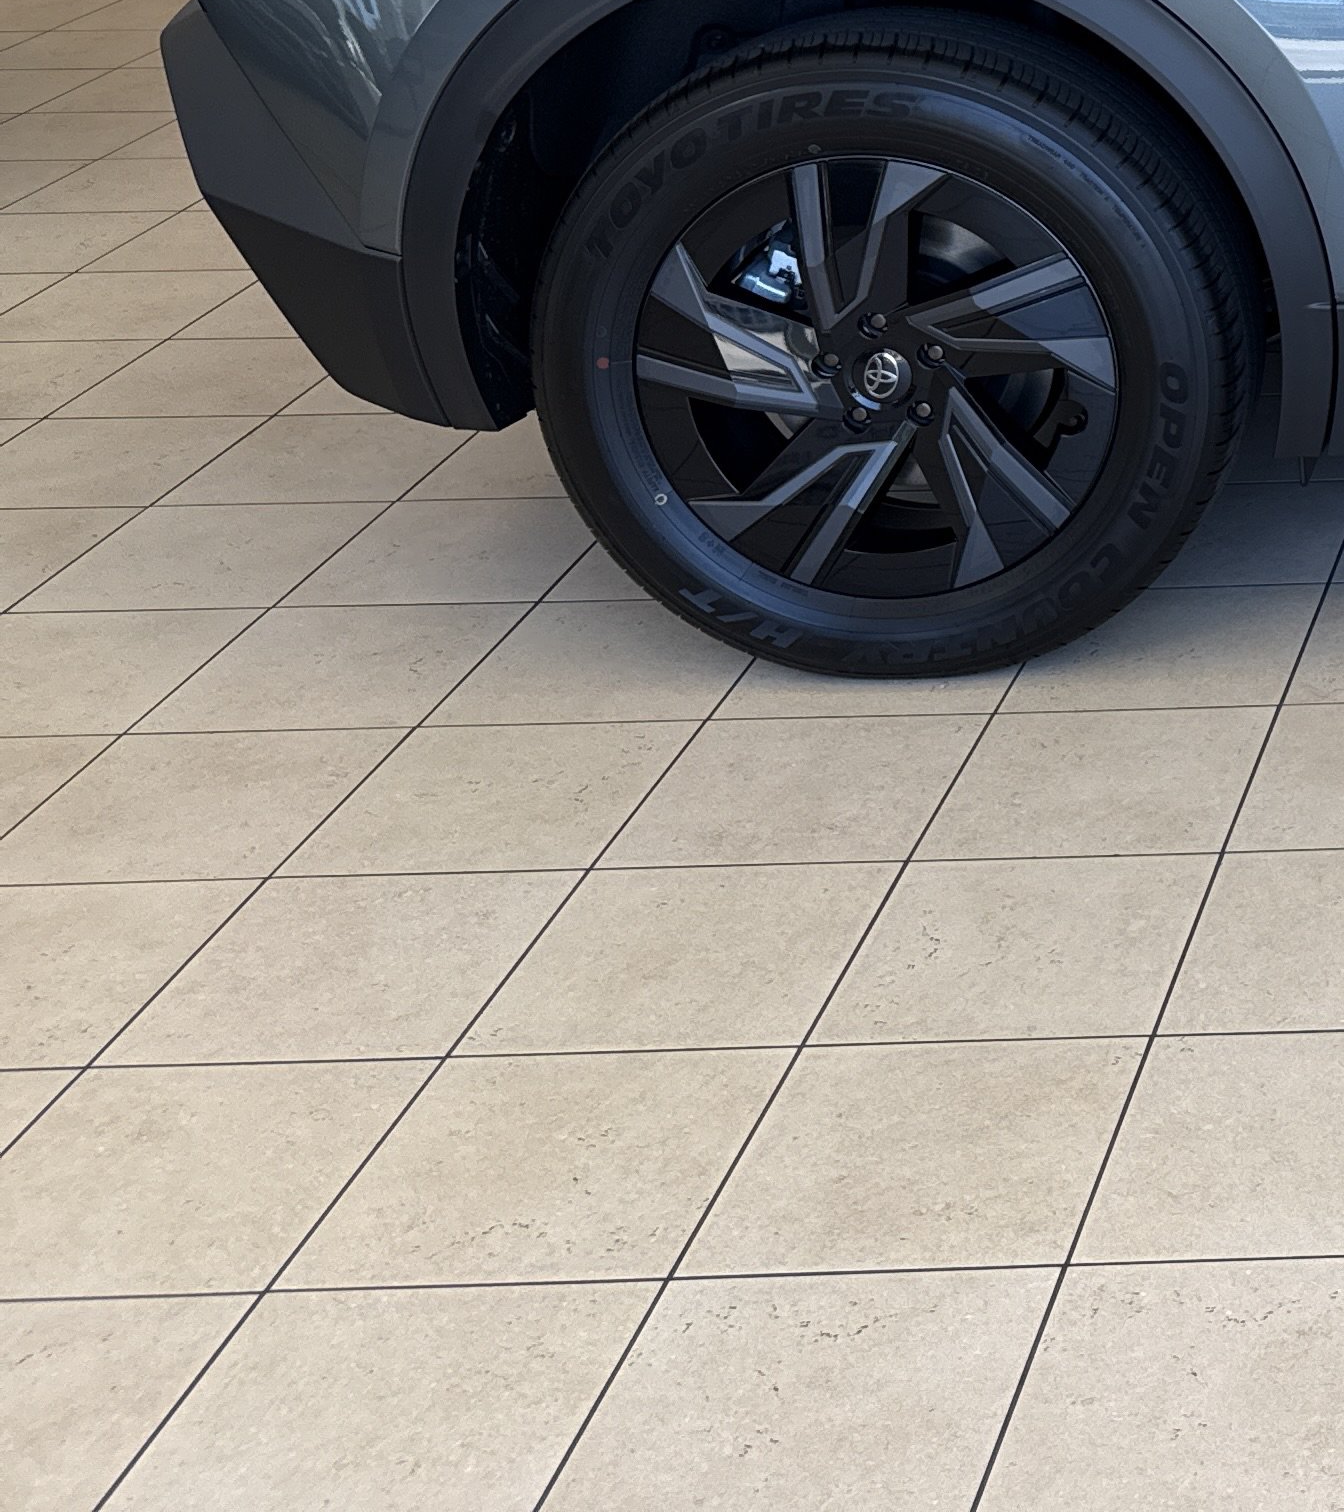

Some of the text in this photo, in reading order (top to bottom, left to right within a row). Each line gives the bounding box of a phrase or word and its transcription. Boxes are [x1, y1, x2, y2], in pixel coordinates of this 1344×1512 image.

[583, 88, 922, 259] TOYO TIRES
[679, 361, 1189, 666] OPEN COUNTRY H/T
